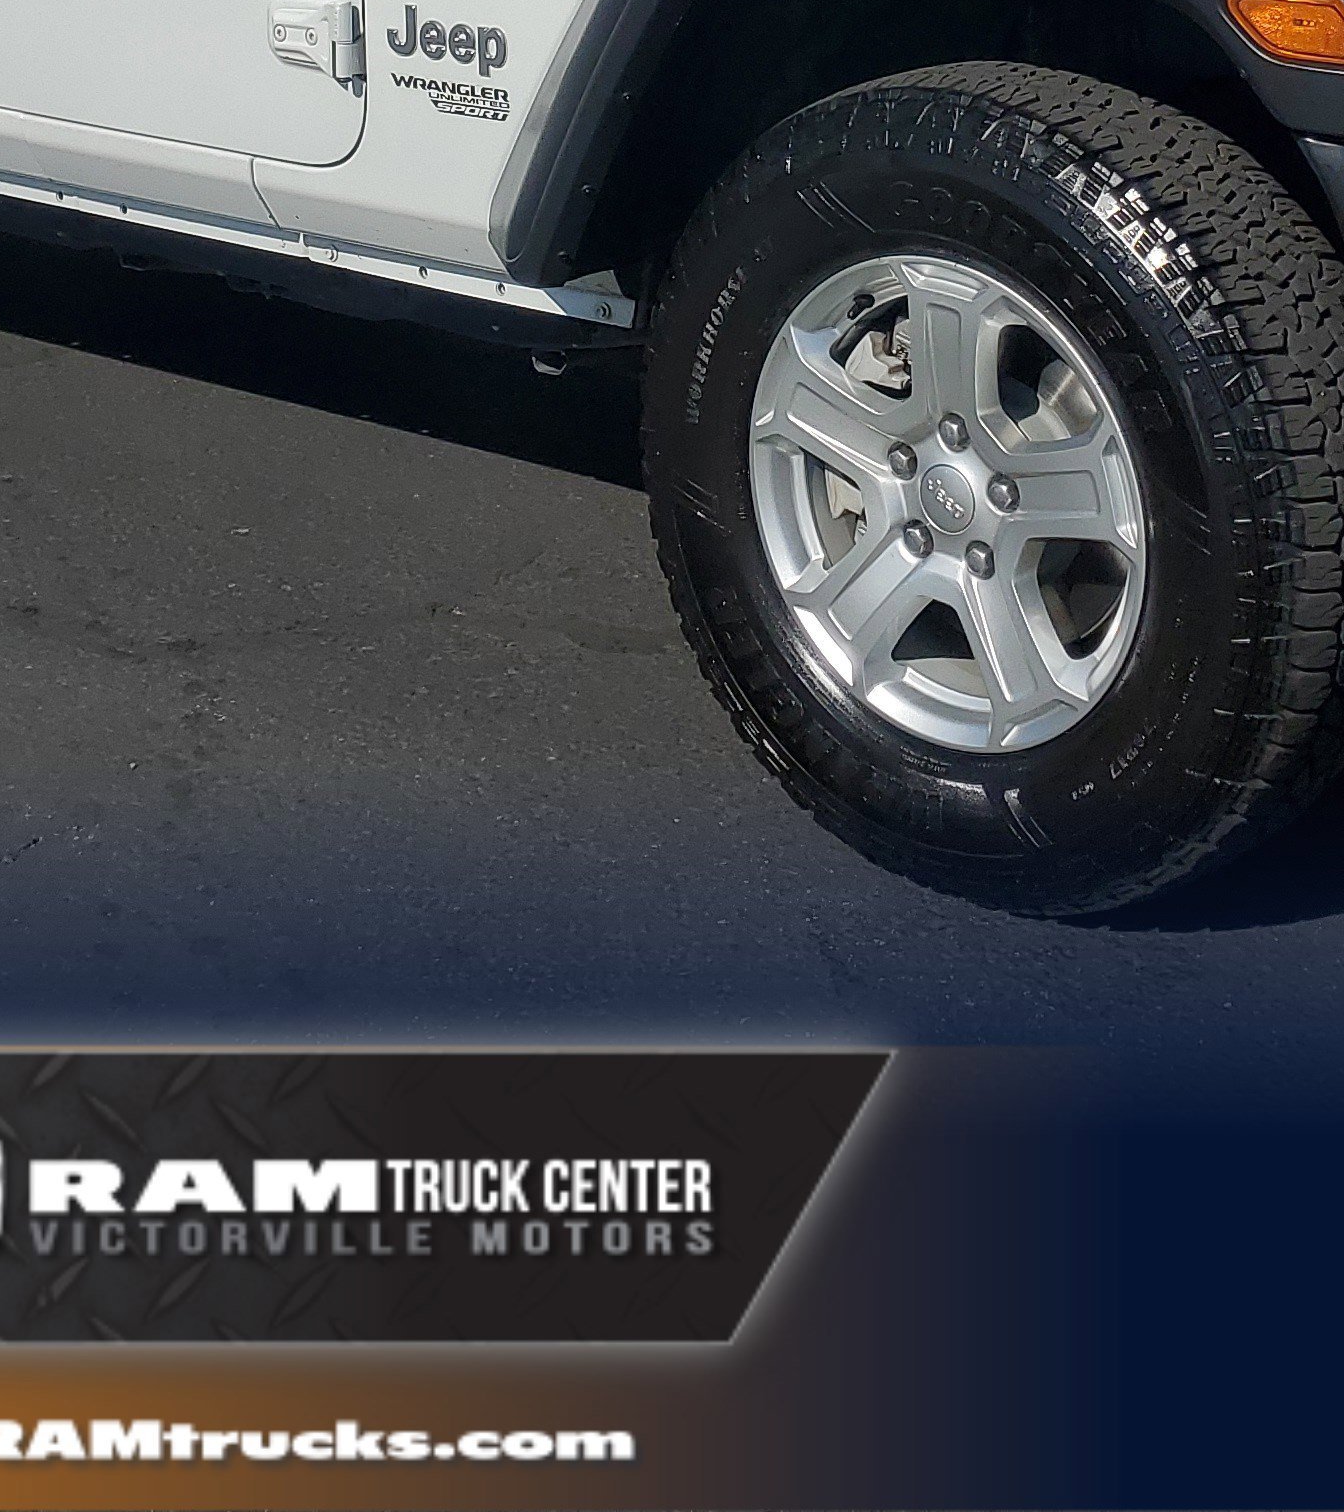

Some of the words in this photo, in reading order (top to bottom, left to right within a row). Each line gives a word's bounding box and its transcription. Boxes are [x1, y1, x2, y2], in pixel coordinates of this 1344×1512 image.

[386, 4, 508, 78] Jeep
[390, 72, 509, 102] WRANGLER
[428, 91, 510, 109] UNLIMITED
[436, 102, 510, 121] SPORT
